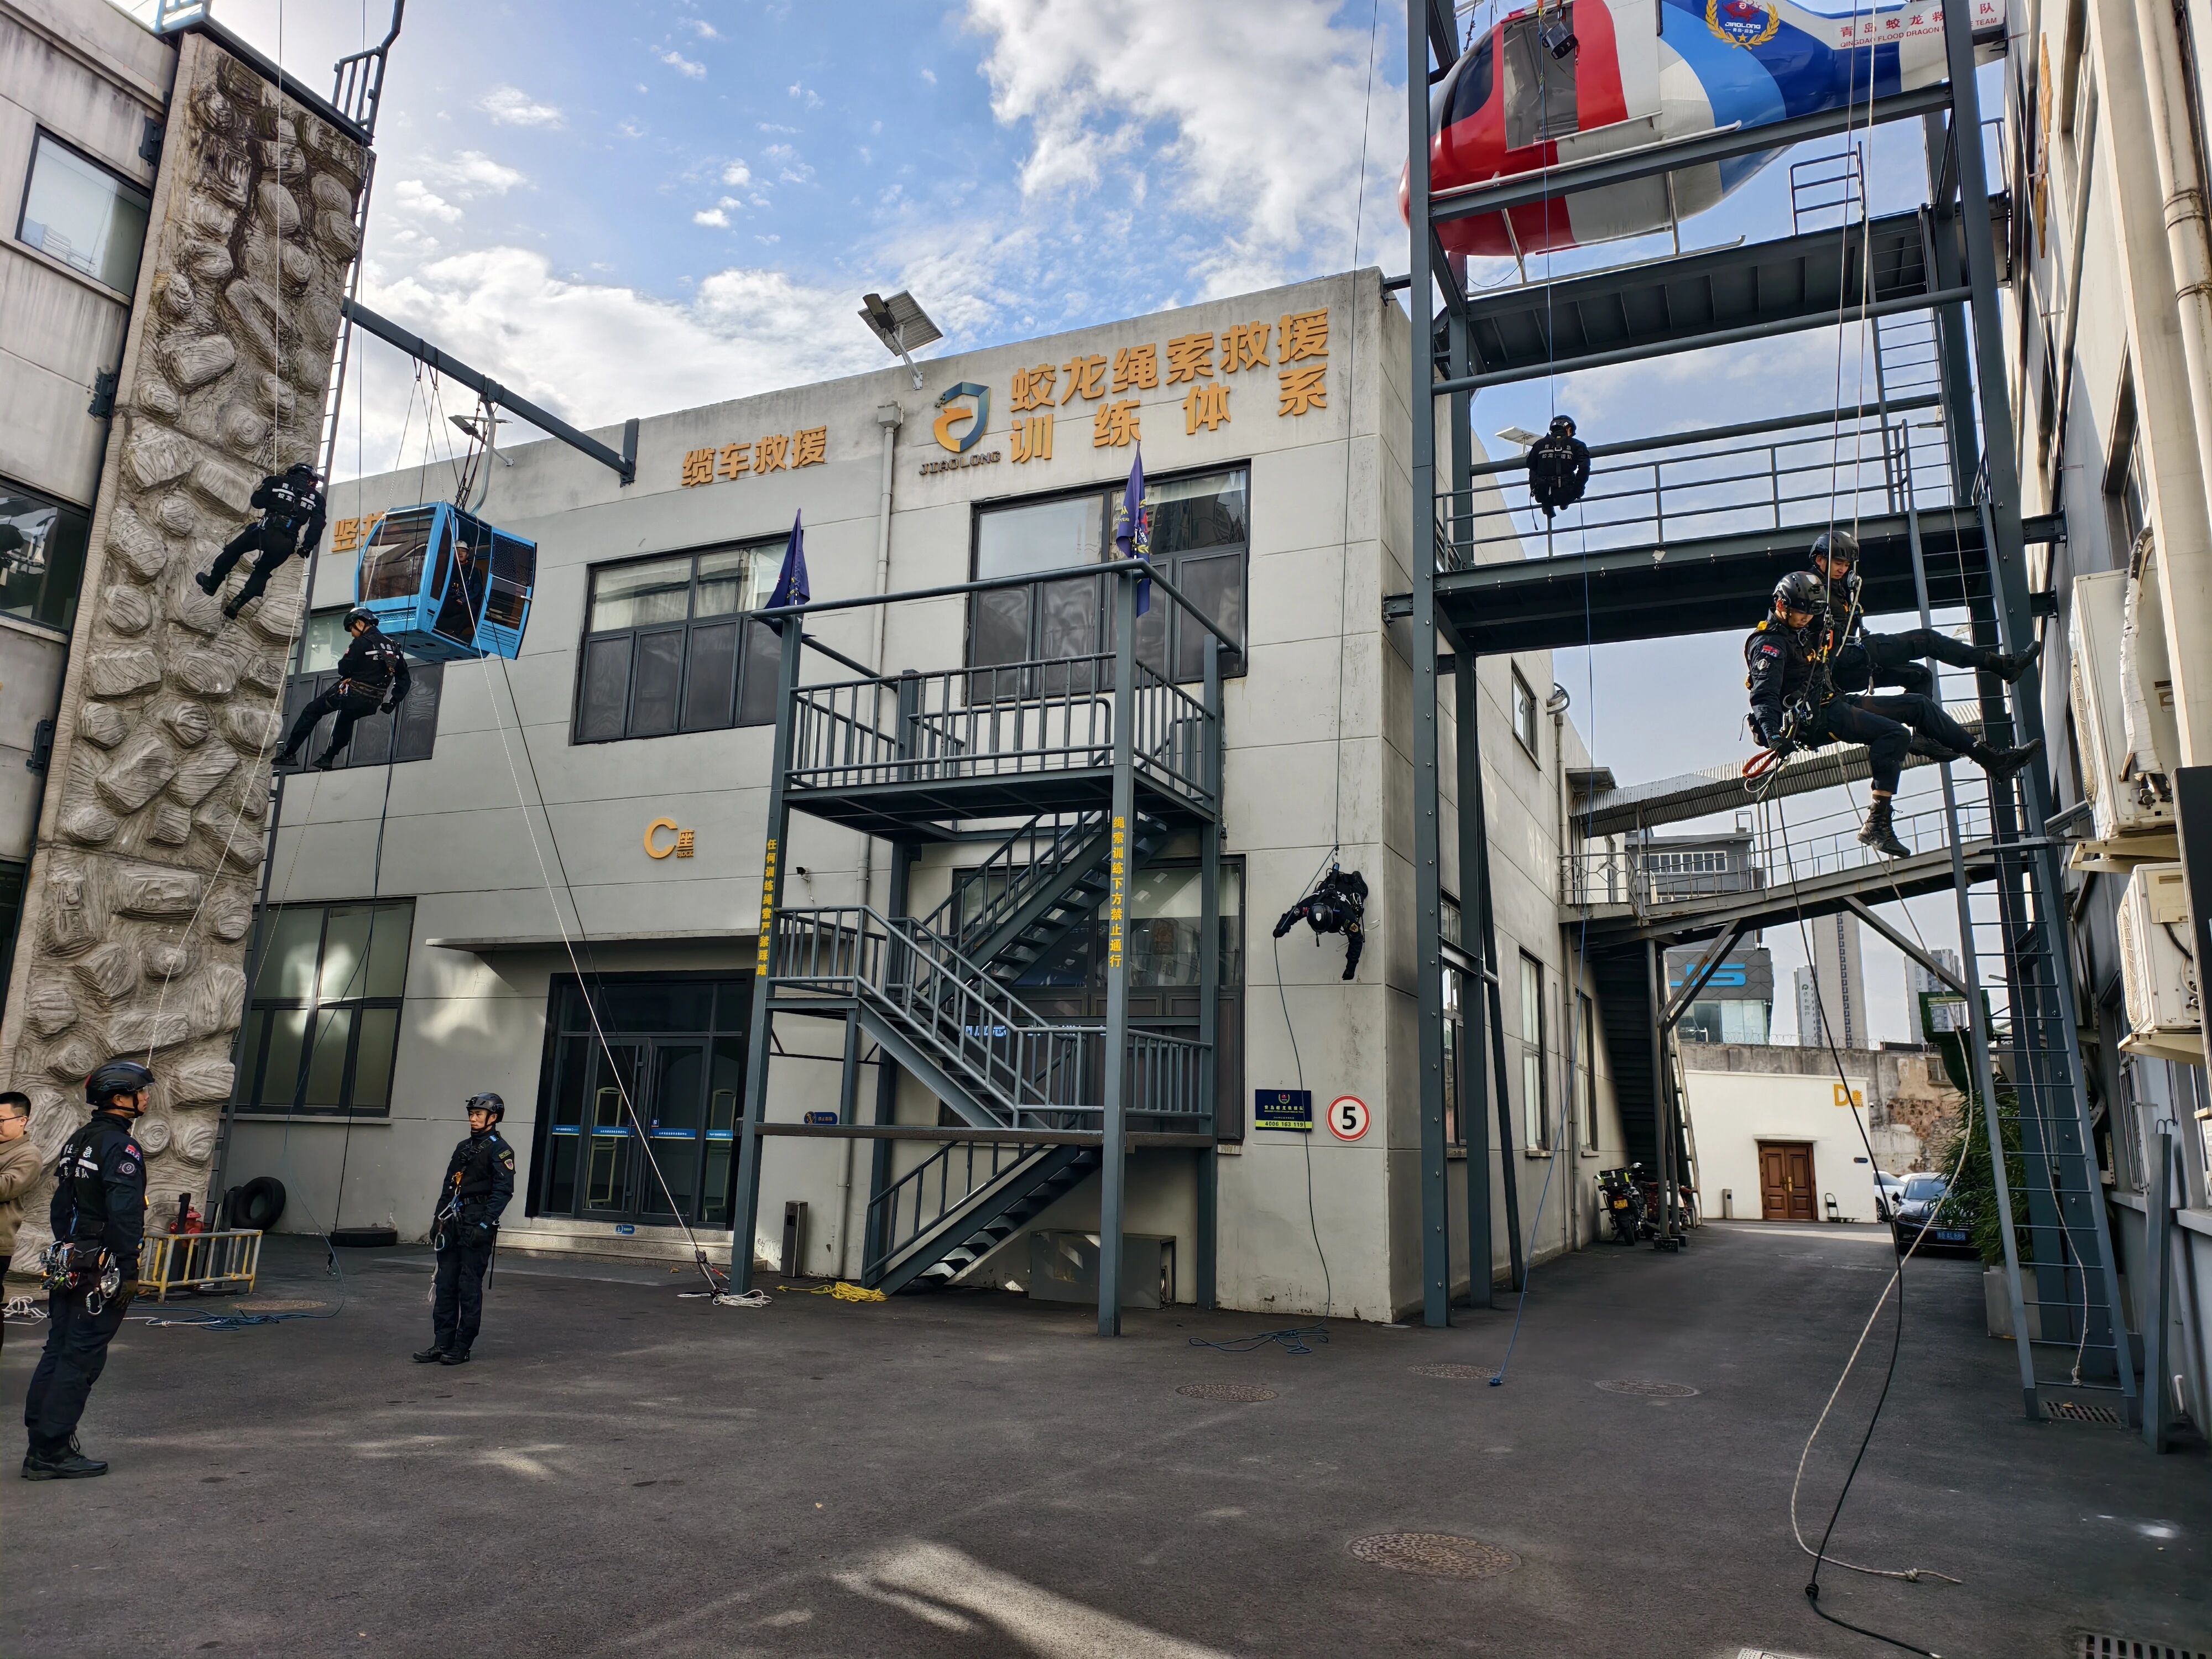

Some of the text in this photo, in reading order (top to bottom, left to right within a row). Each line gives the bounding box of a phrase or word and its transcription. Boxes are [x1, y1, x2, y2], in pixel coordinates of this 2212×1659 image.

[1840, 37, 1875, 48] QINGDAO
[1877, 32, 1903, 41] FLOOD
[1906, 27, 1939, 36] DRAGON
[1975, 17, 1997, 27] TEAM
[1009, 306, 1328, 412] 蛟龙绳索救援
[681, 425, 826, 487] 缆车救援
[919, 450, 1001, 475] JIAOLONG
[756, 838, 777, 976] 任何训练绳索严禁踩踏
[1109, 816, 1125, 968] 绳索训练下方禁止通行
[1342, 1106, 1357, 1130] 5
